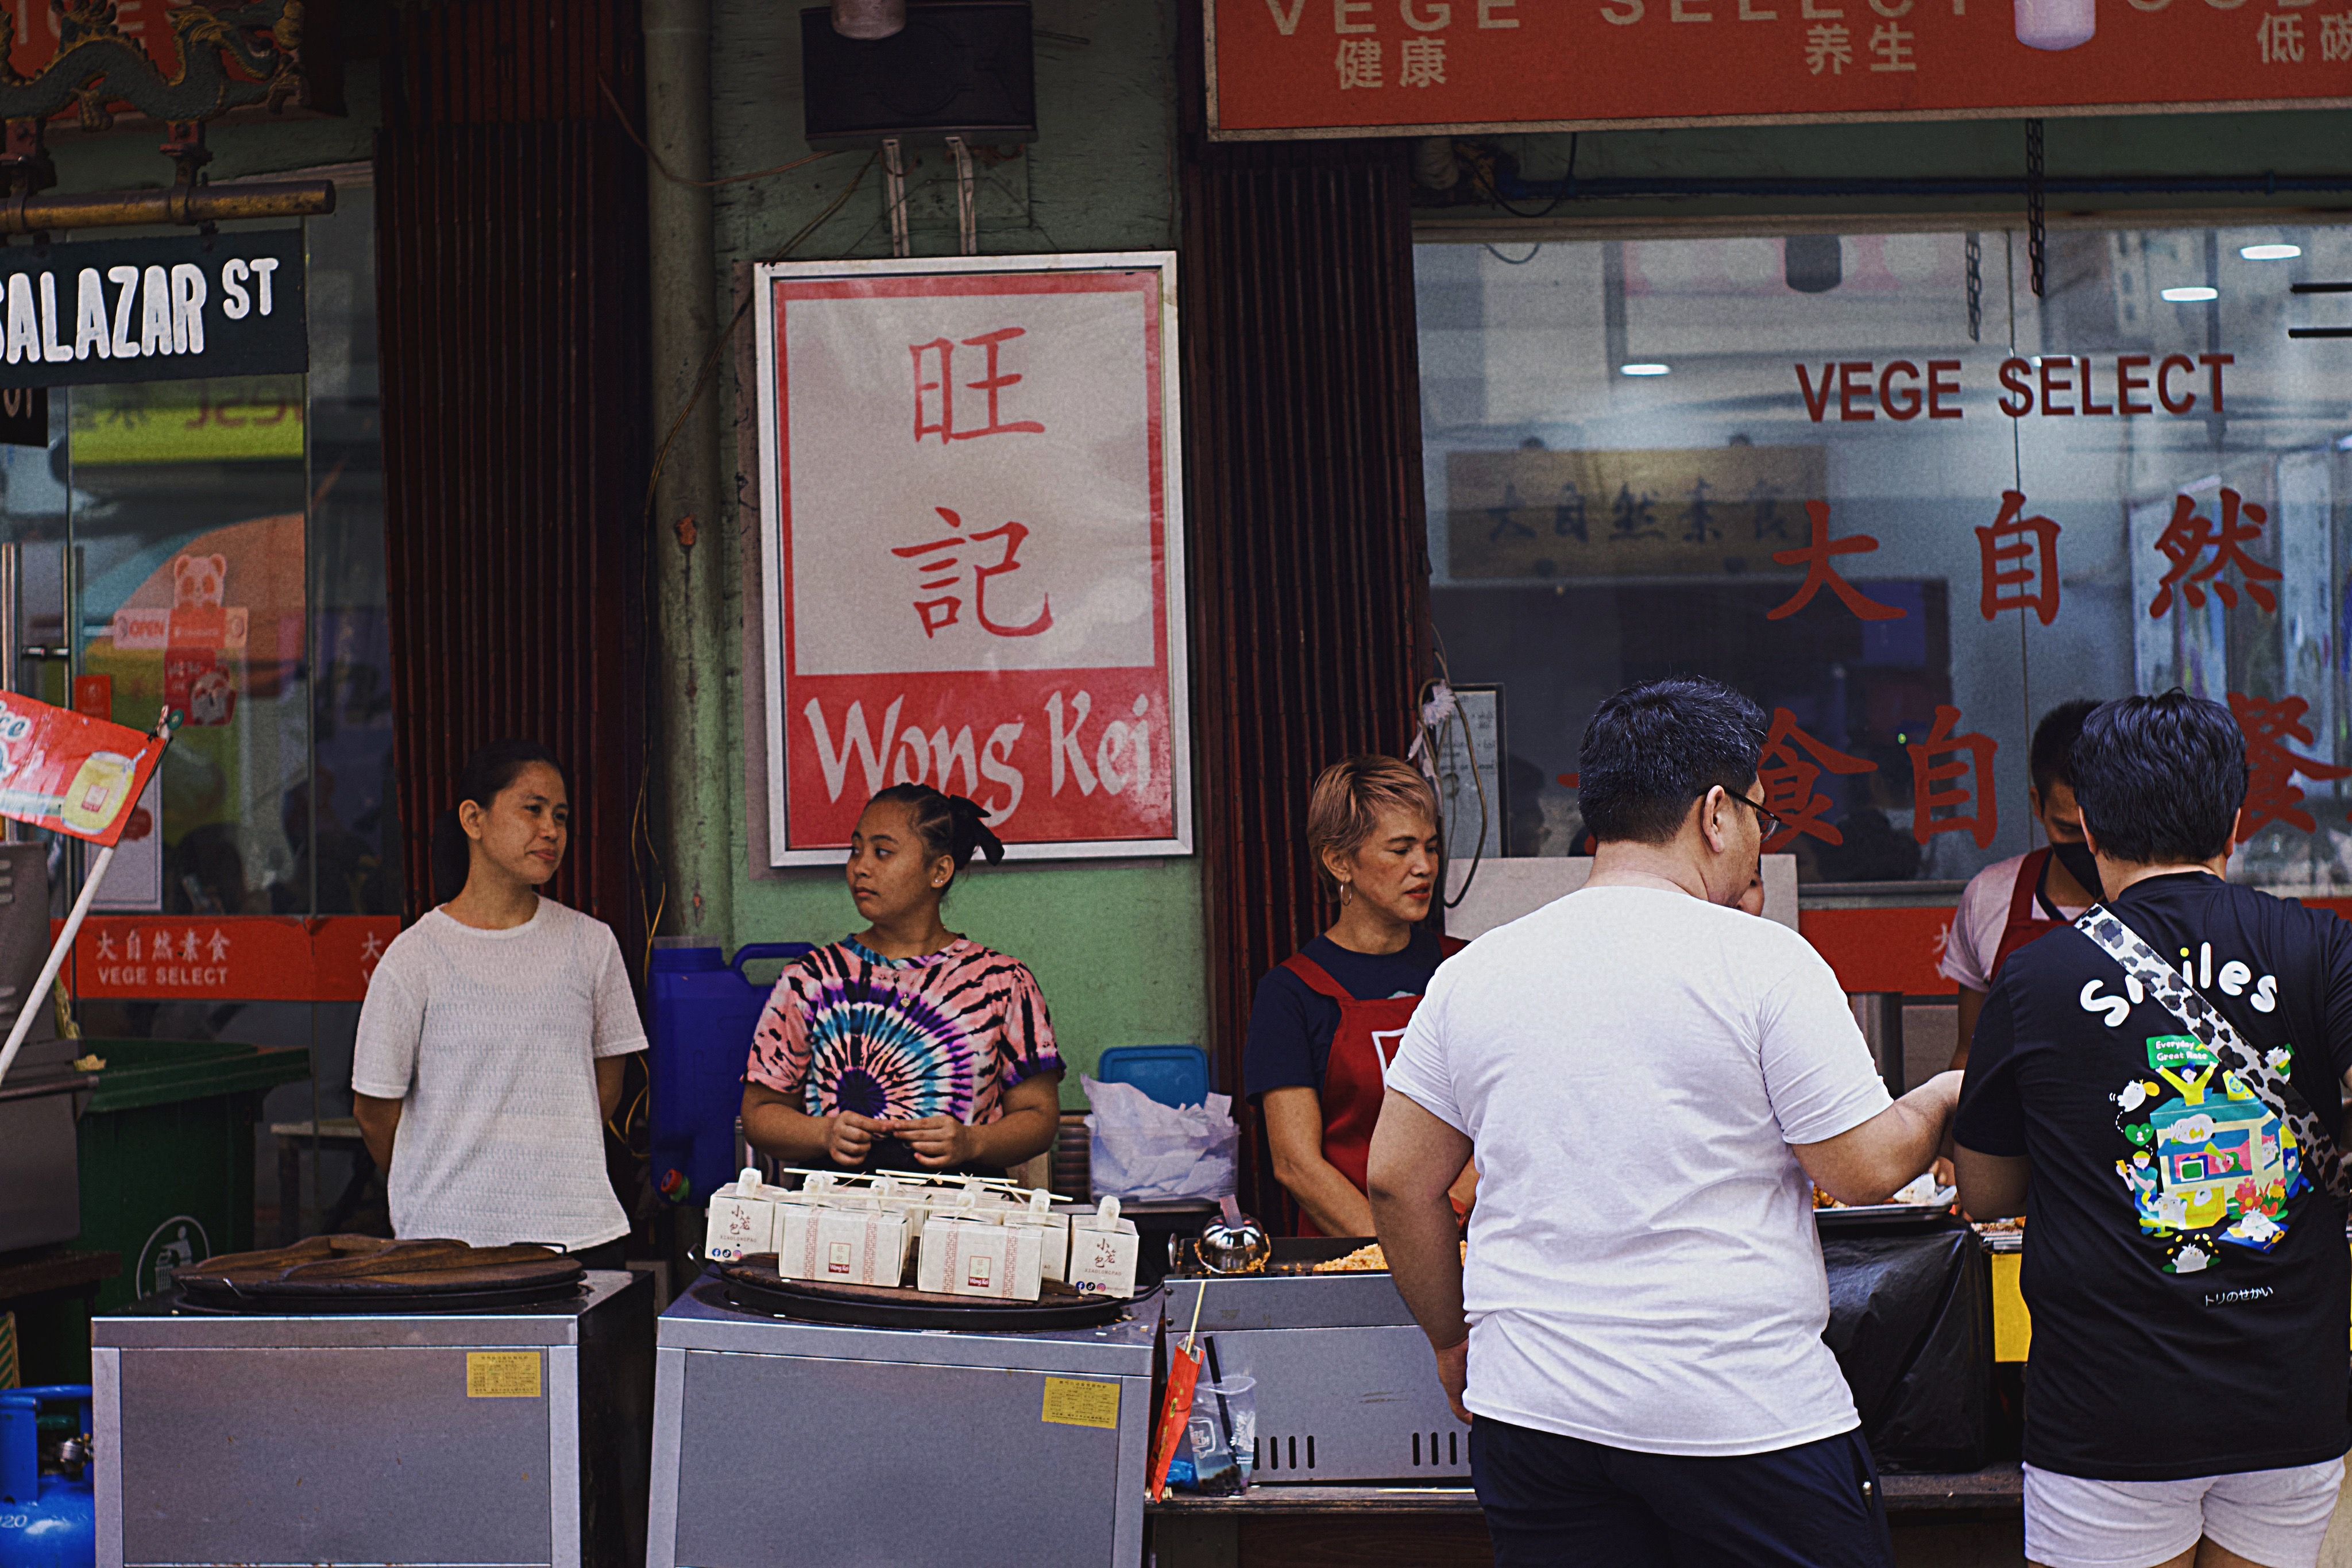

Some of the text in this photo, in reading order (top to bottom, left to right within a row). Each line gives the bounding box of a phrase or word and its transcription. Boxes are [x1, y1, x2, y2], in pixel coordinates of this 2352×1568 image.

[1335, 37, 1447, 90] 健康
[1805, 22, 1917, 75] 养生
[0, 258, 280, 364] ALAZAR ST
[1795, 354, 2235, 422] VEGE SELECT
[891, 326, 1053, 639] 旺記
[1767, 487, 2284, 627] 大自然
[129, 621, 165, 638] OPEN
[804, 690, 1150, 828] Wong Kei
[95, 928, 230, 963] 大自然素食
[98, 965, 227, 985] VEGE SELECT
[2156, 1040, 2195, 1051] Everyday
[2157, 1052, 2184, 1061] Great
[2205, 1285, 2273, 1307] トリのせかい
